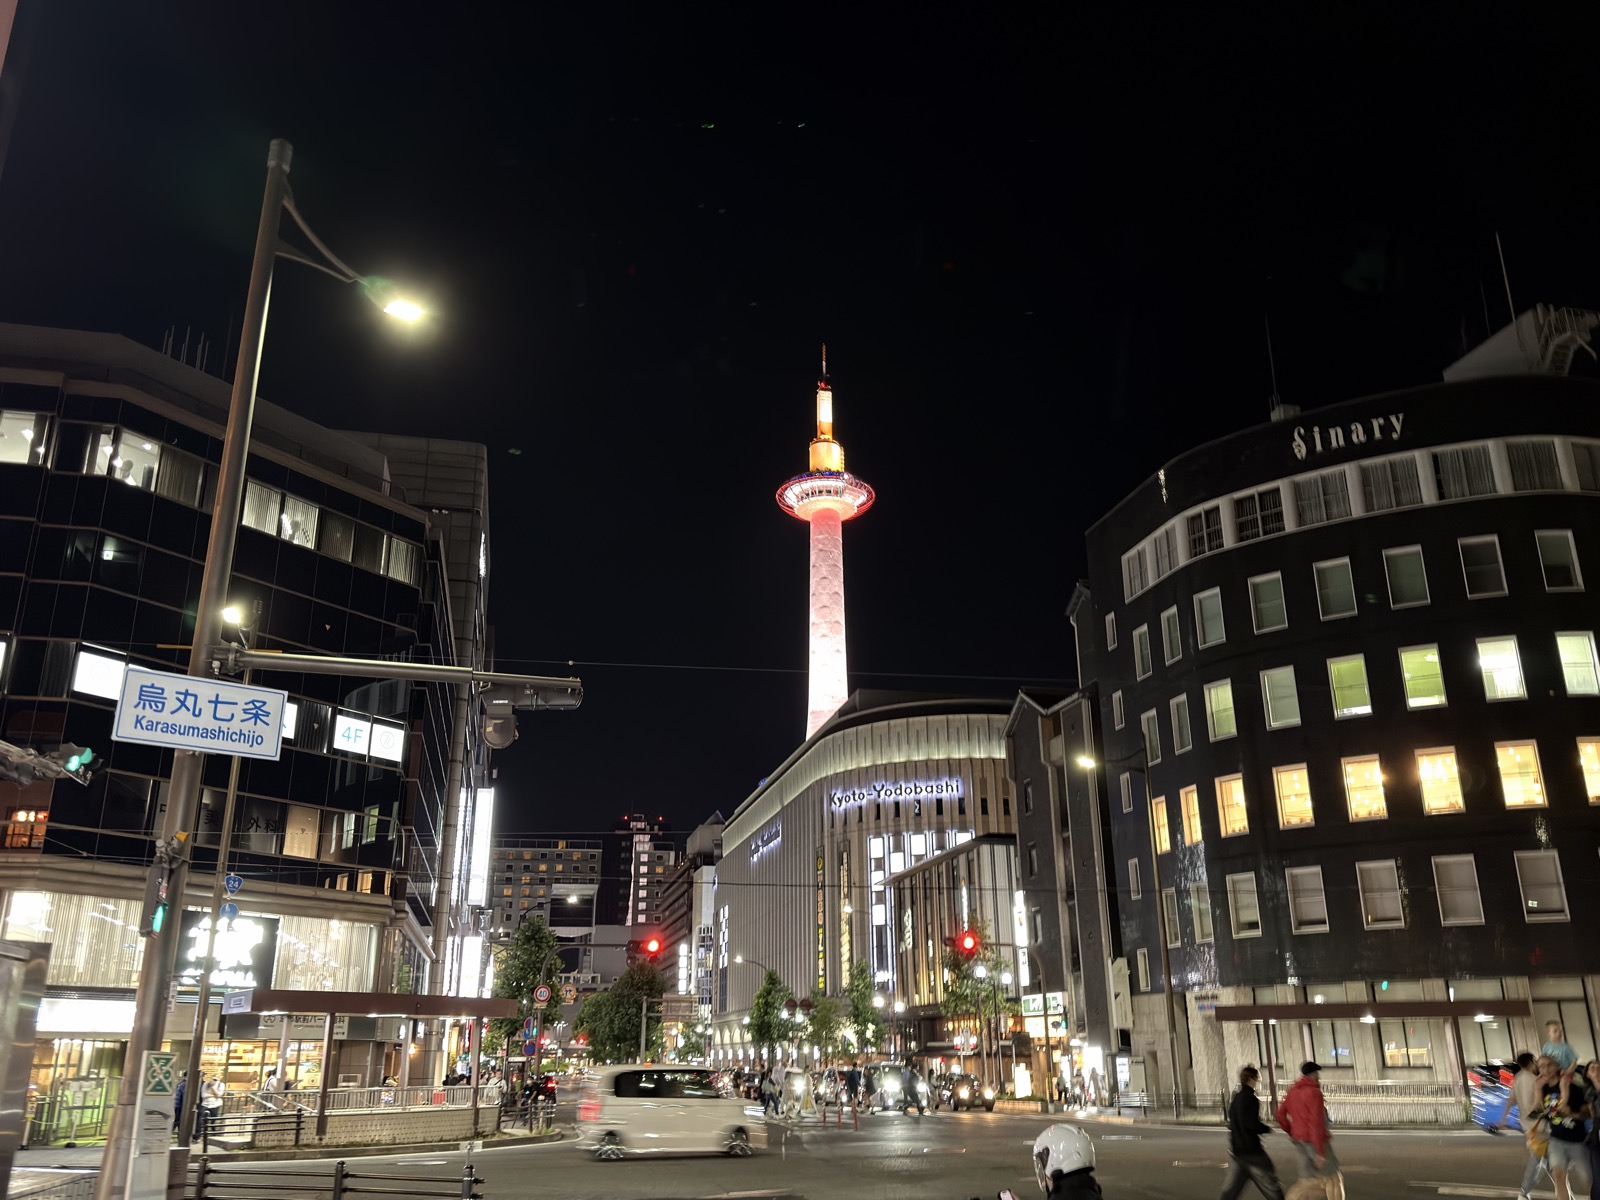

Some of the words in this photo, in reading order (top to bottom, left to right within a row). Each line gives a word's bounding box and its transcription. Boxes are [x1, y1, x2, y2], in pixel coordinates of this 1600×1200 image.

[1291, 412, 1405, 461] Sinary
[133, 682, 272, 727] 烏丸七条
[134, 714, 264, 748] Karasumashichijo
[341, 726, 364, 744] 4F
[829, 779, 960, 808] Kyoto-Yodobashi
[538, 990, 547, 998] 40
